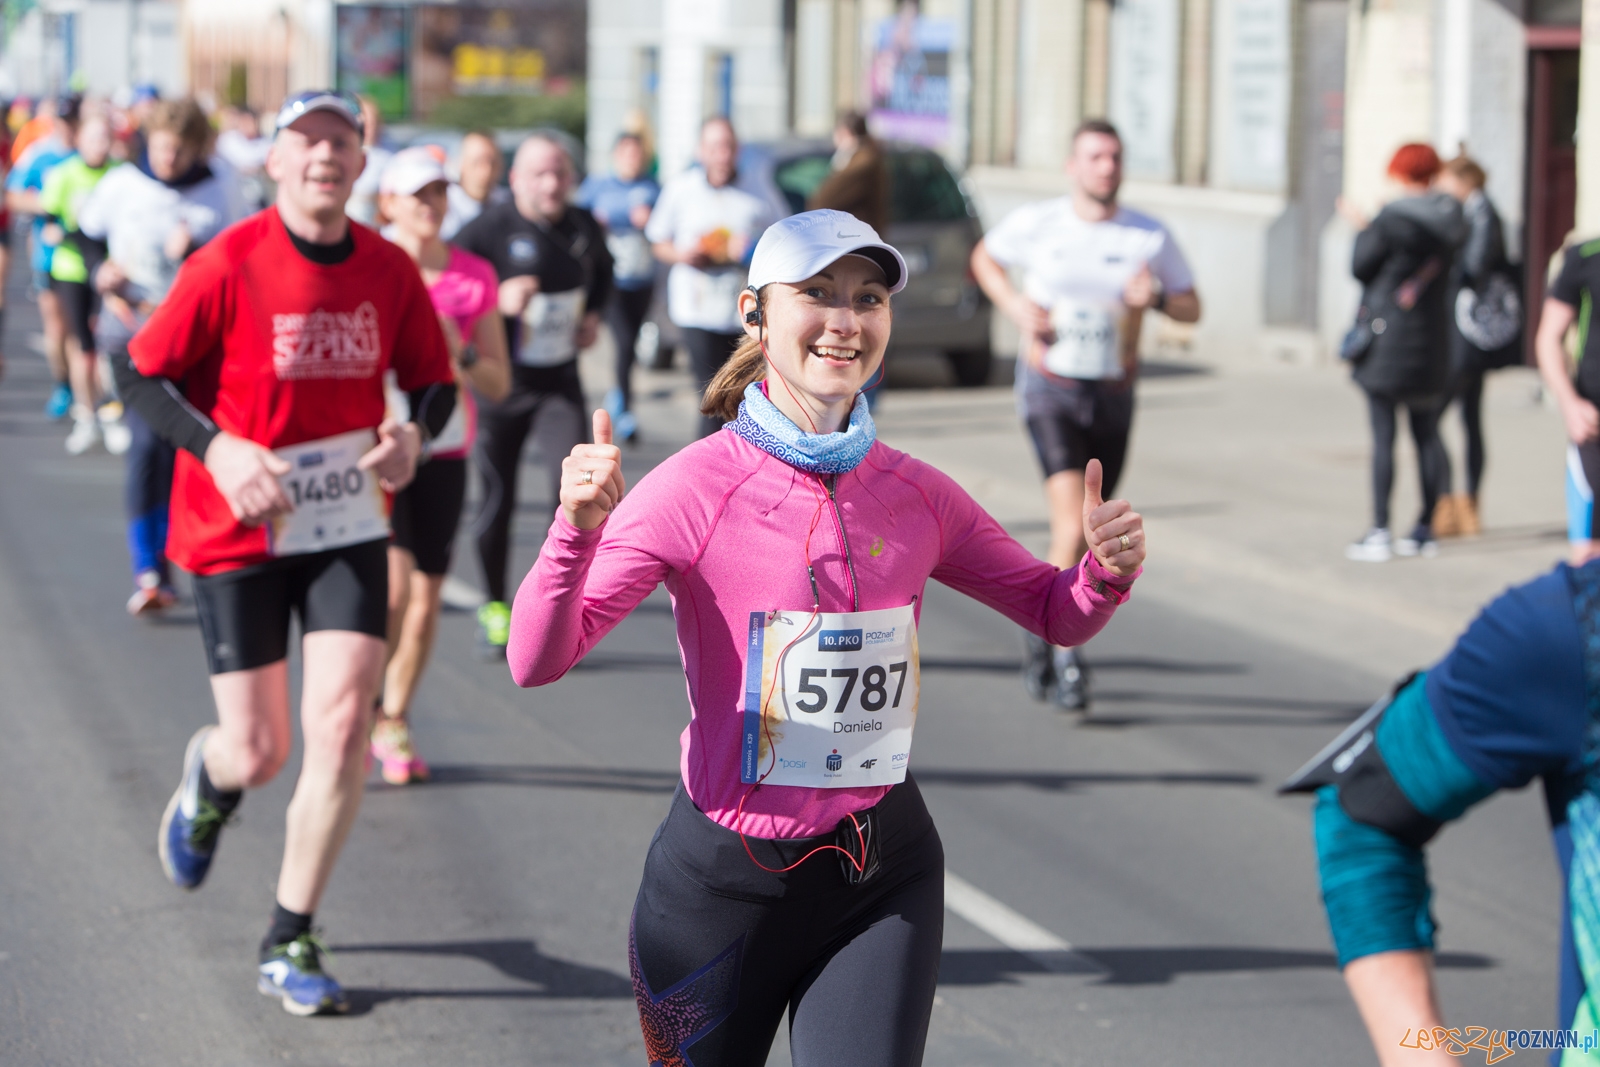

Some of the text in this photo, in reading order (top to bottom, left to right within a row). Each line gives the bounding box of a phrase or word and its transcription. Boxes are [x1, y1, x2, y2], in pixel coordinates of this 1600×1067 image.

[288, 466, 363, 506] 1480
[823, 635, 860, 646] 10. PKO
[795, 661, 908, 713] 5787
[833, 719, 882, 734] Daniela
